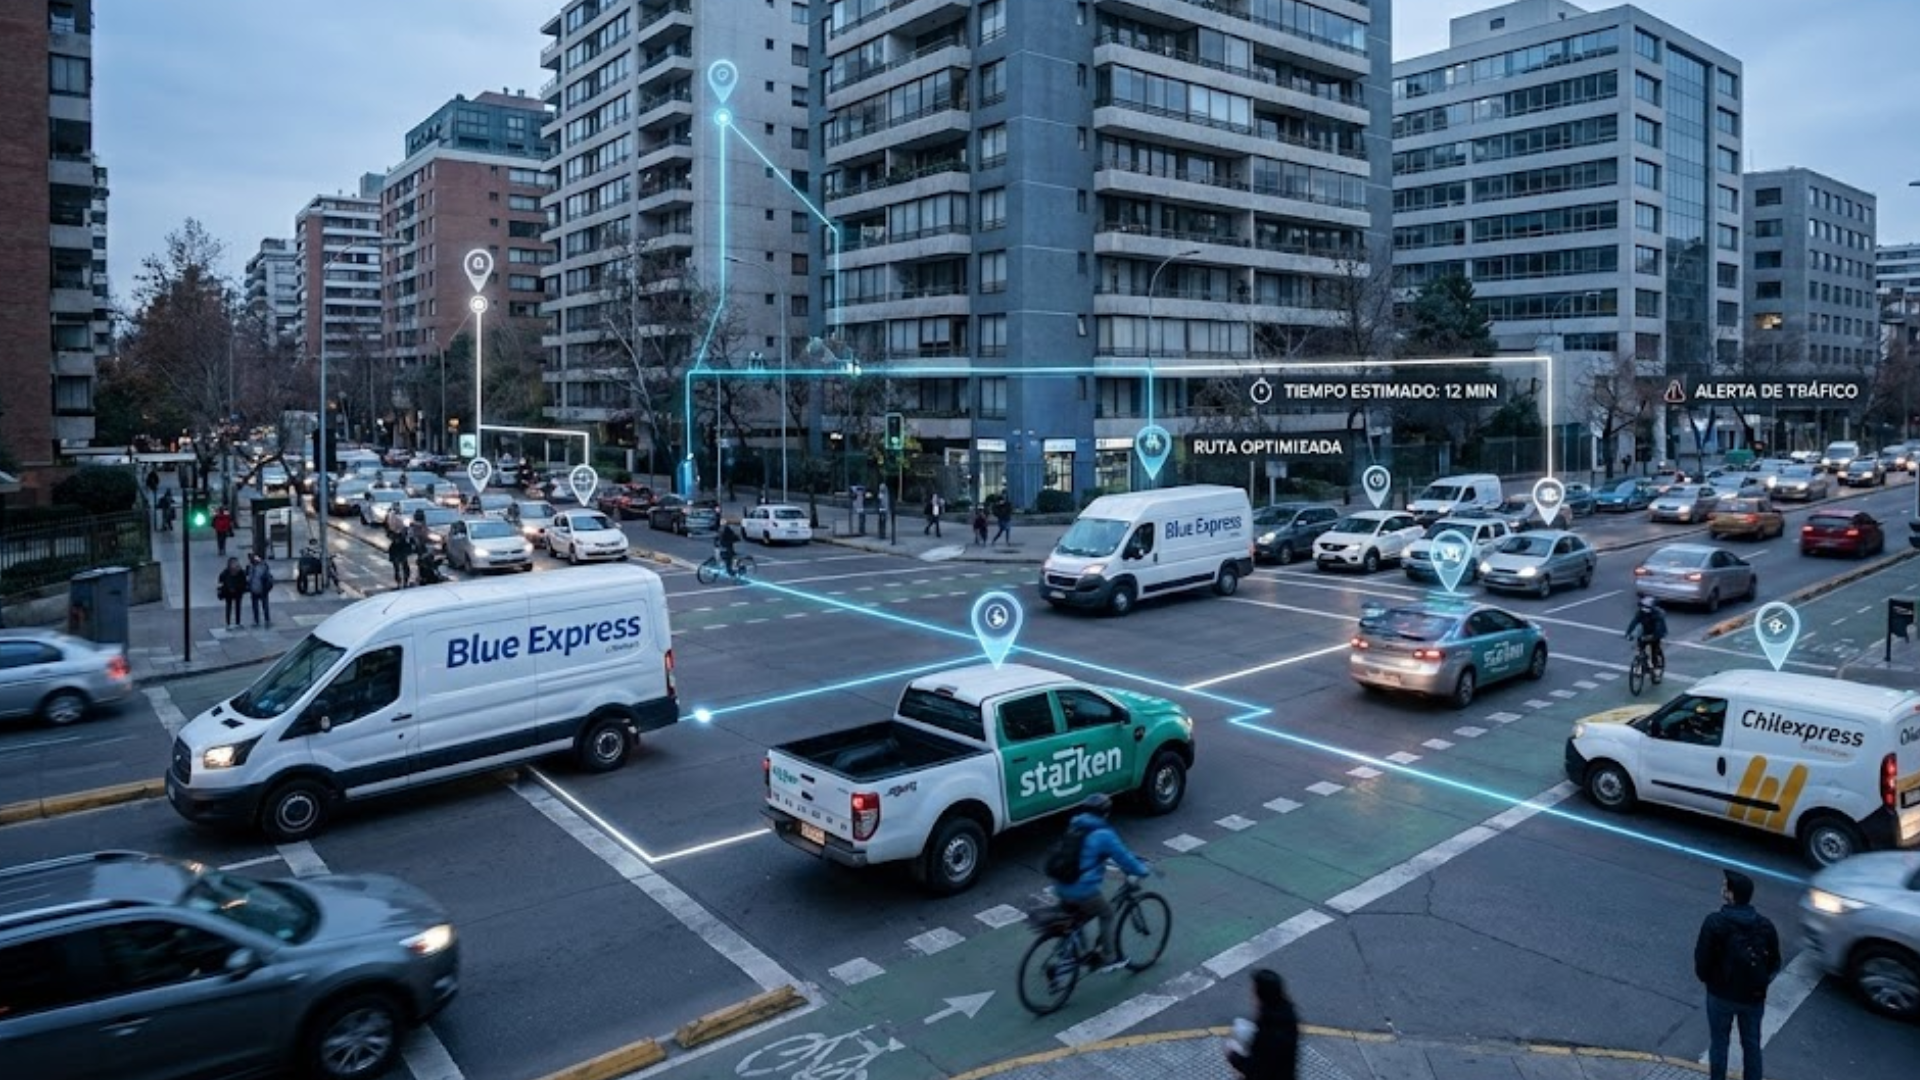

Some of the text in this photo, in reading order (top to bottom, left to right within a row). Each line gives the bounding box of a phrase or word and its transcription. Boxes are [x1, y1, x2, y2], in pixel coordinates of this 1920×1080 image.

[1165, 516, 1242, 540] Blue Express
[446, 615, 641, 668] Blue Express
[1741, 709, 1865, 748] Chilexpress
[1020, 747, 1122, 797] starken
